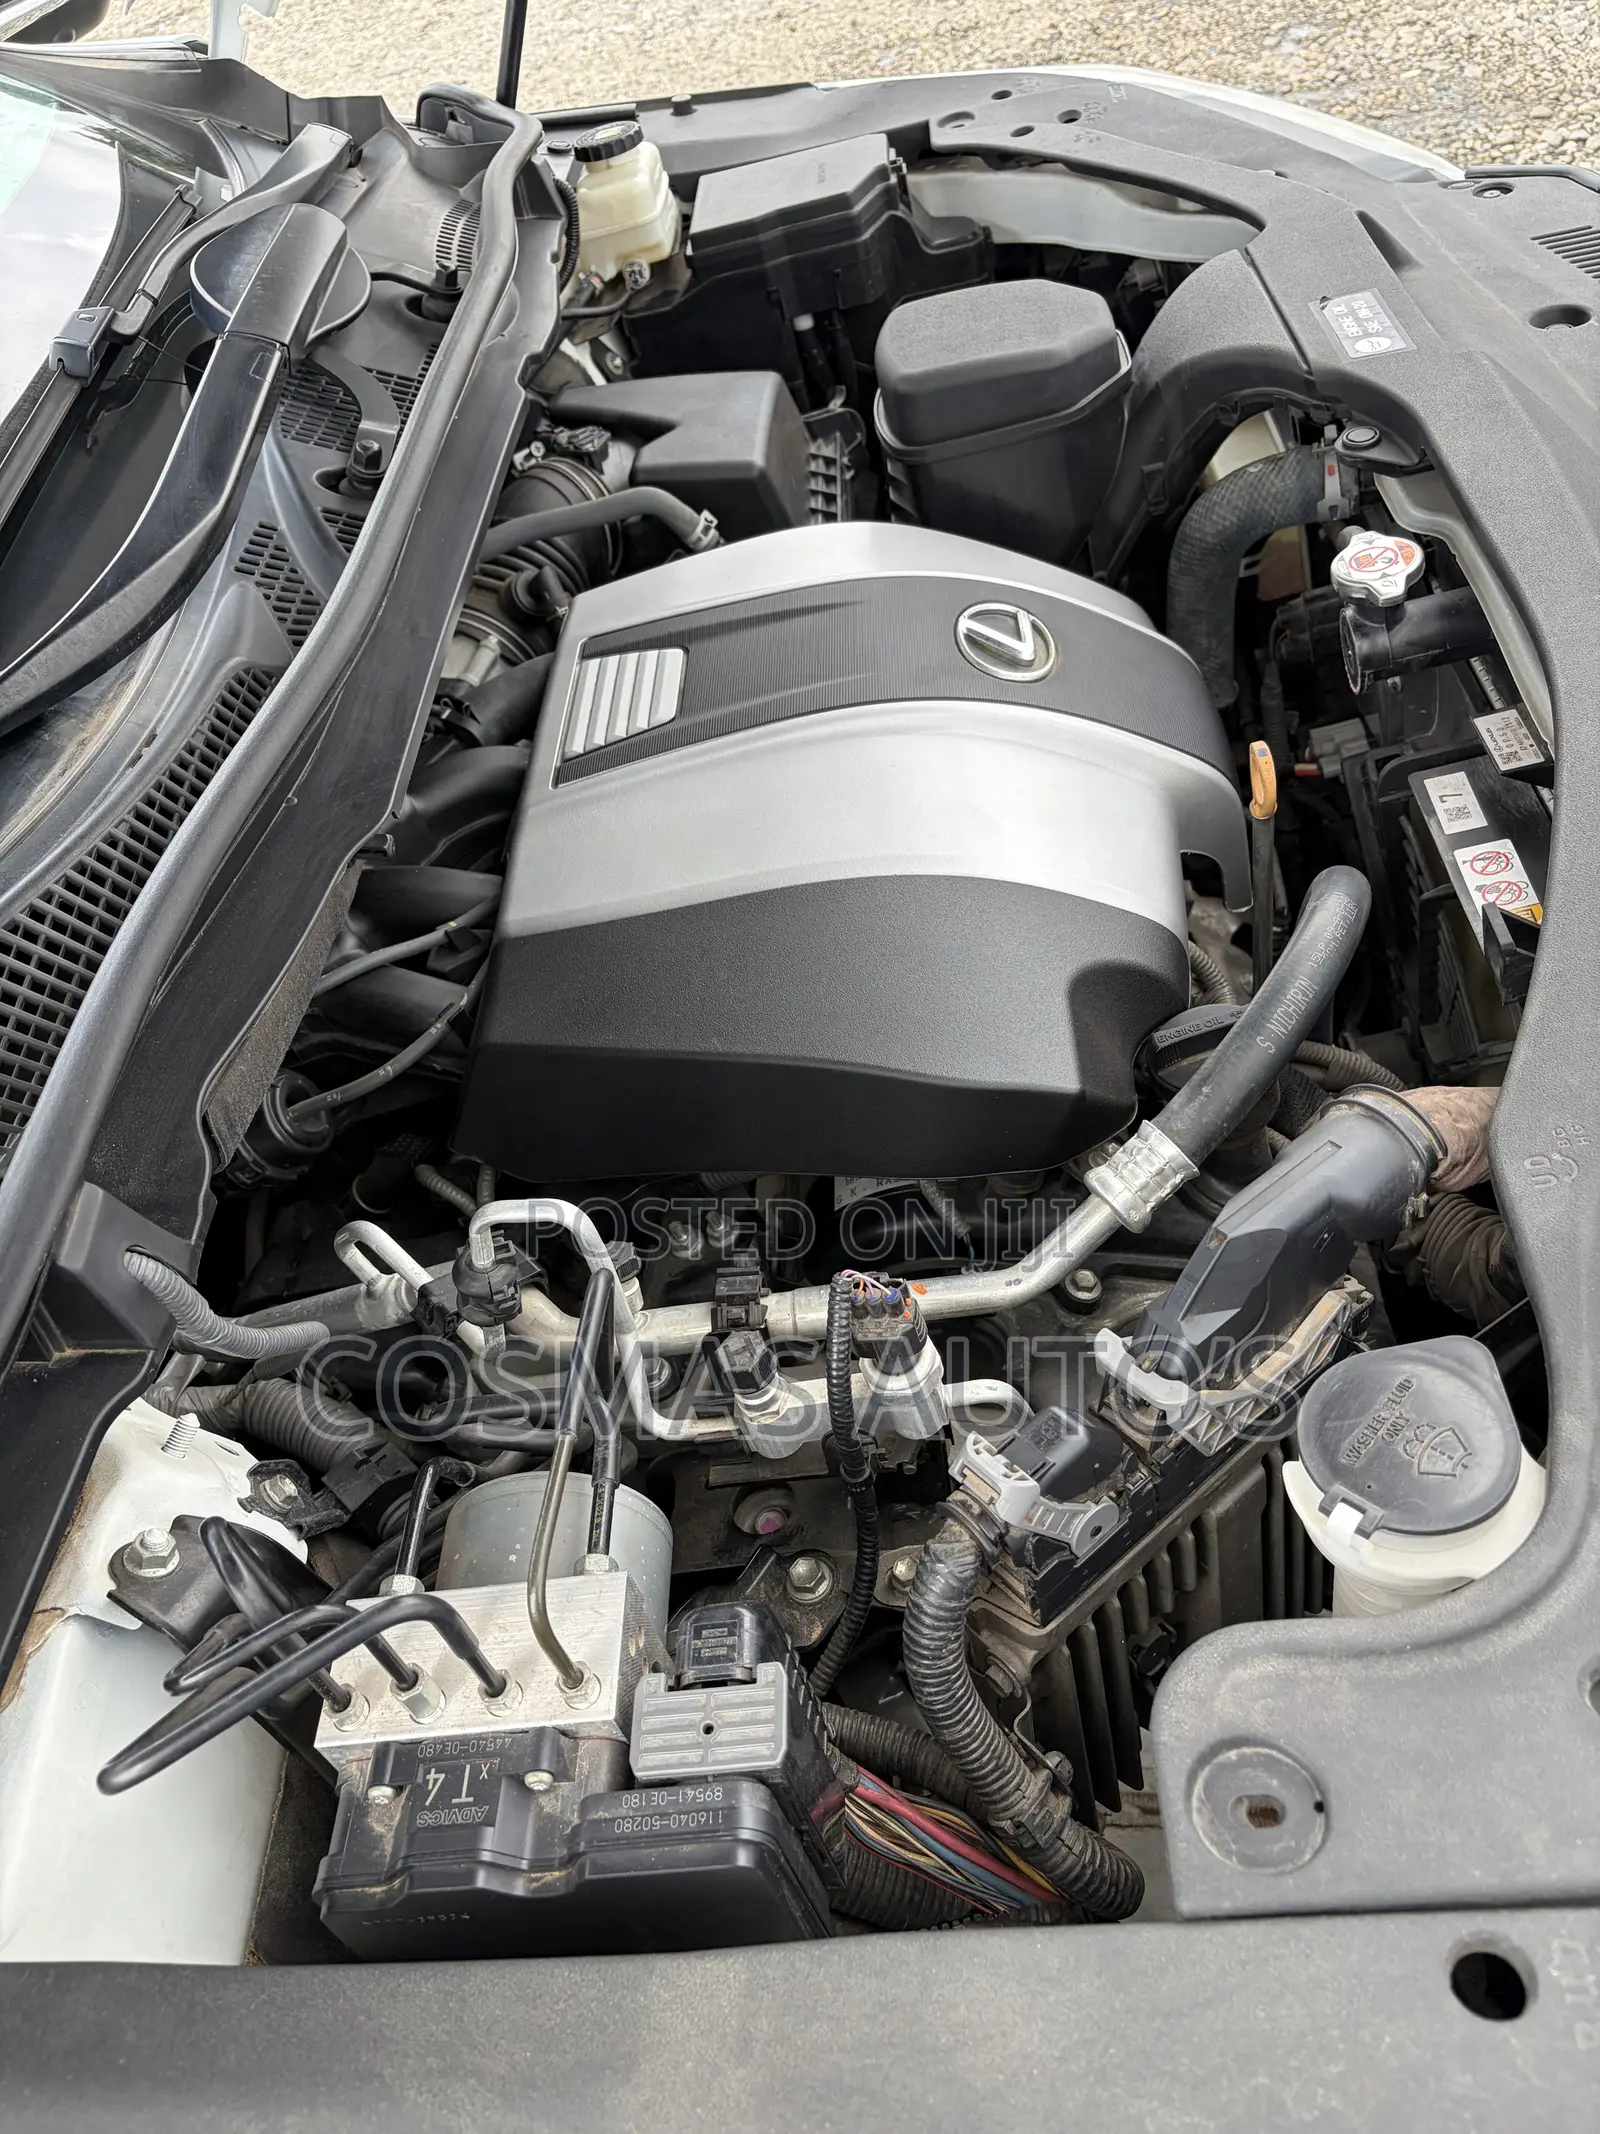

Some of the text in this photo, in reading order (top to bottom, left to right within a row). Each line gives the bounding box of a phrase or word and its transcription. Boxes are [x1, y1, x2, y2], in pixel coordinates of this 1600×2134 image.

[1156, 1016, 1224, 1044] ENGINE OIL
[1342, 1377, 1415, 1467] WASHER FLUID
[1381, 1411, 1410, 1445] ONLY
[417, 1738, 512, 1758] 44540-0E480
[622, 1787, 723, 1808] 89541-0E180
[417, 1806, 490, 1827] ADVICS
[614, 1810, 723, 1833] 116040-50280
